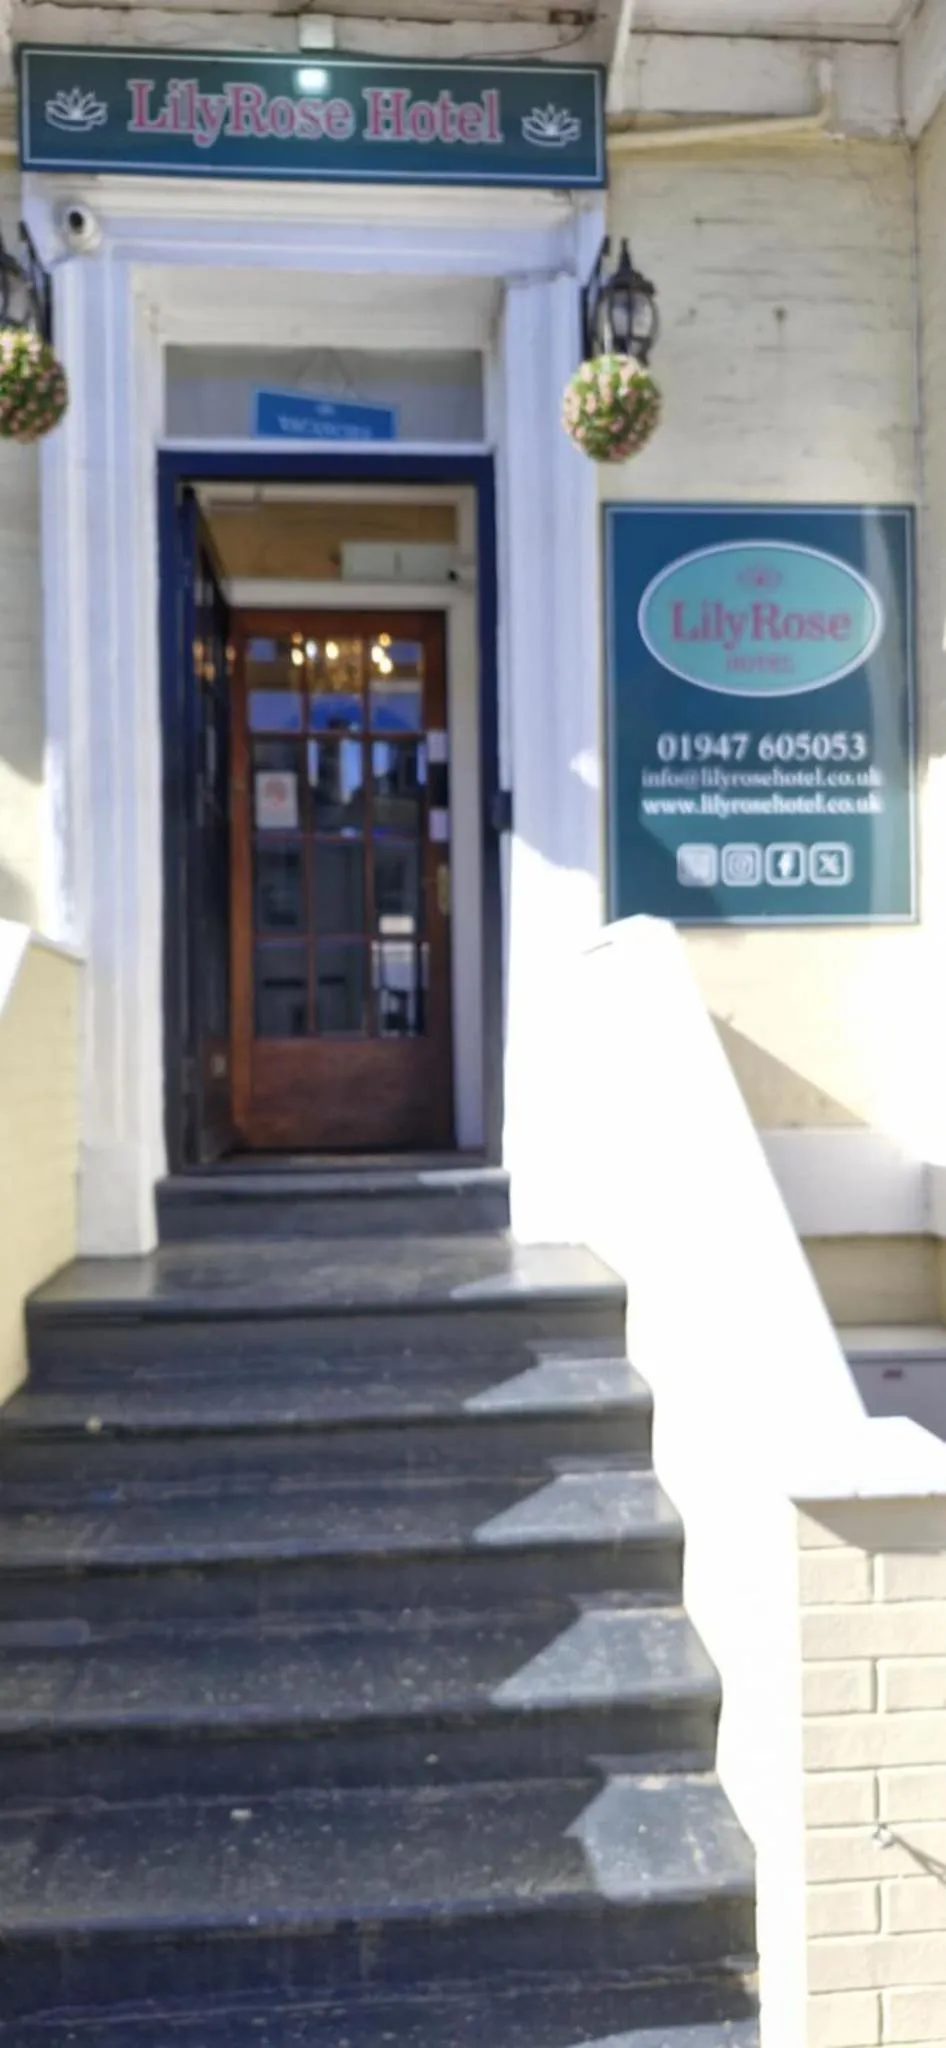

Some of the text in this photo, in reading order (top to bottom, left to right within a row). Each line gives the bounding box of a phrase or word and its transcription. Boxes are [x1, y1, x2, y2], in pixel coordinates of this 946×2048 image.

[127, 79, 503, 147] LilyRose Hotel
[671, 599, 852, 650] LilyRose
[657, 732, 867, 761] 01947 605053
[641, 766, 881, 792] info@lilyrosehotel.co.uk
[641, 792, 881, 819] www.lilyrosehotel.co.uk
